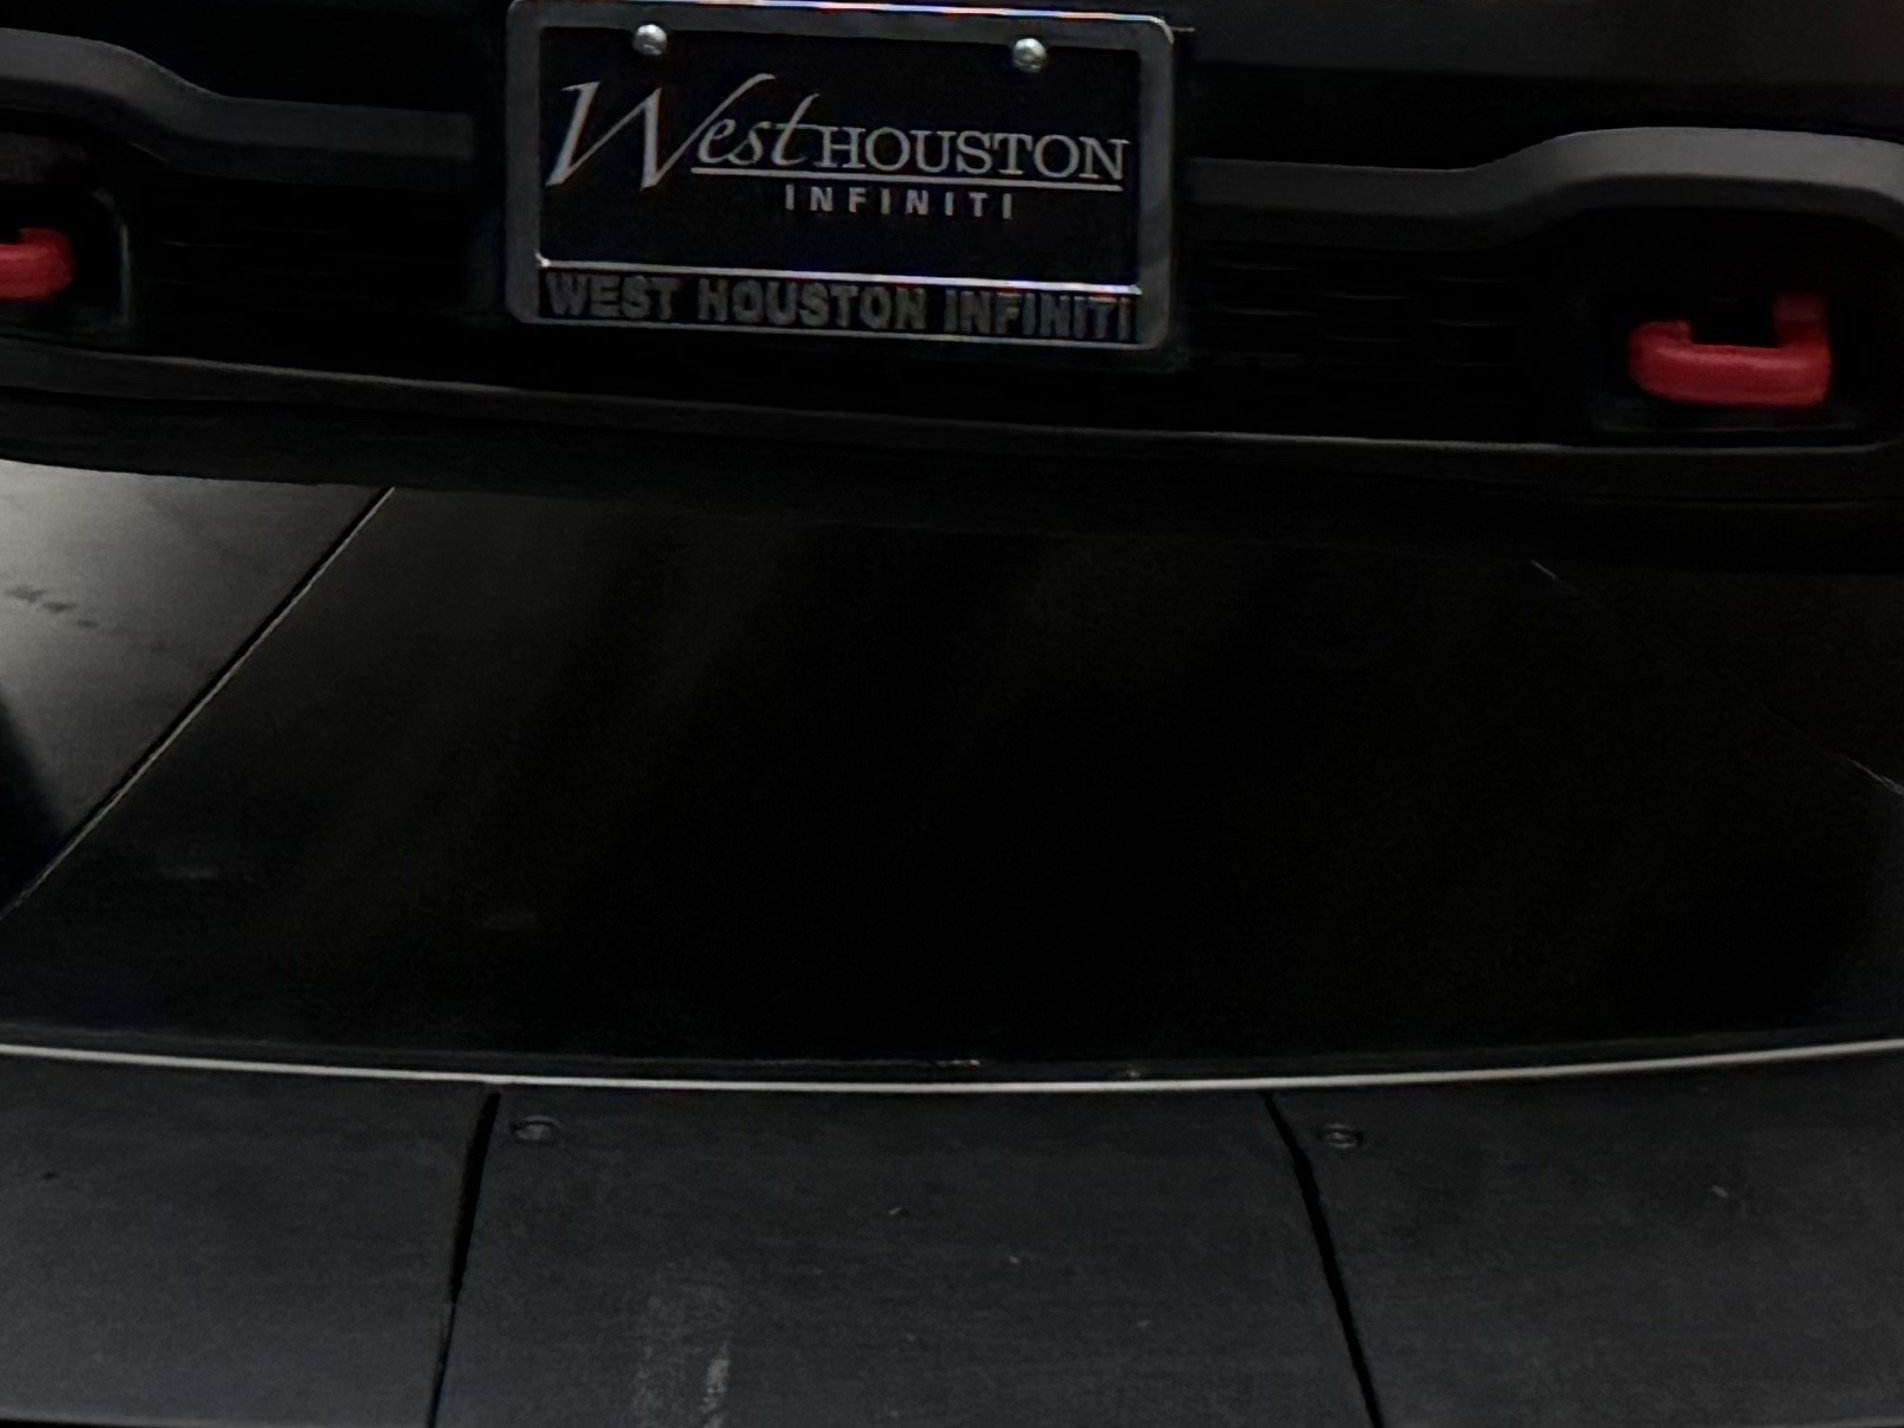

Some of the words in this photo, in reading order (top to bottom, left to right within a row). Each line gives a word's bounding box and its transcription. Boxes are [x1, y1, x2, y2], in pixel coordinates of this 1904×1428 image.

[545, 72, 820, 191] West
[821, 125, 1131, 181] HOUSTON
[784, 183, 1015, 220] INFINITI
[546, 271, 678, 321] WEST
[698, 280, 927, 330] HOUSTON
[943, 288, 1137, 342] INFINITI
